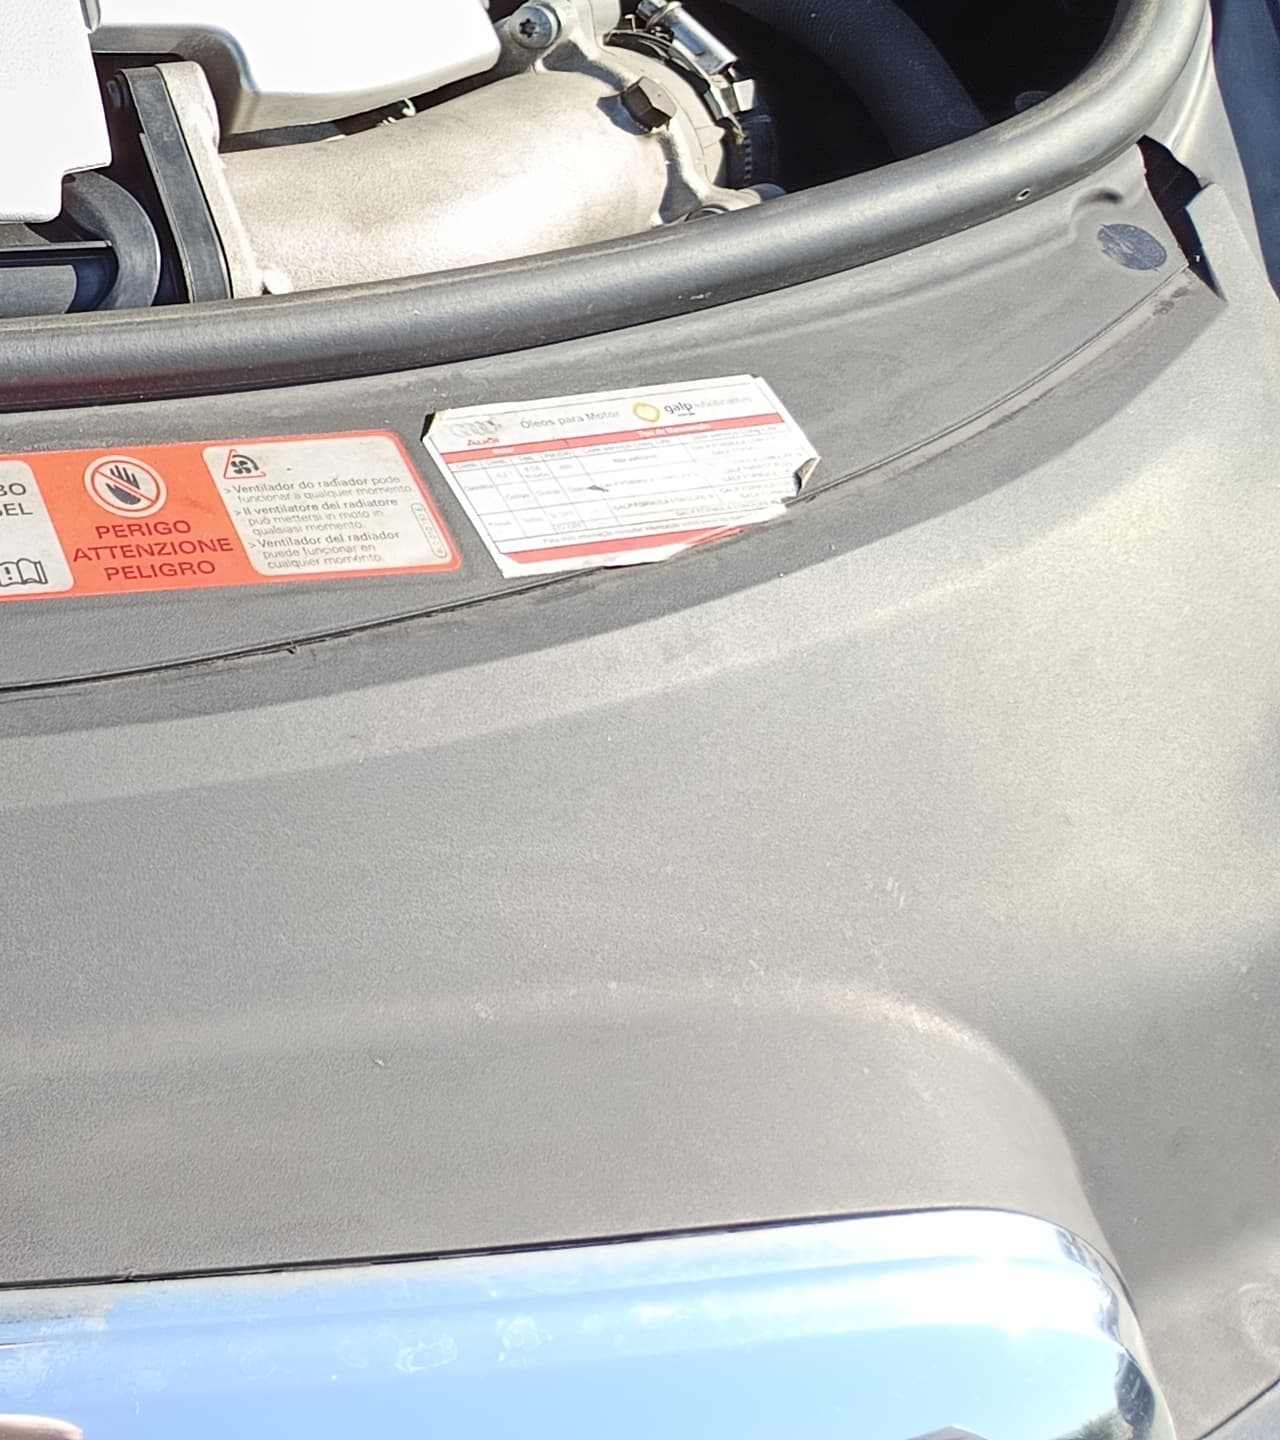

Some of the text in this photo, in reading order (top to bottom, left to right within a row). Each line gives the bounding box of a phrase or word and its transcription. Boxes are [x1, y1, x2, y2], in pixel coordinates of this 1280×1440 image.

[664, 402, 694, 414] galp
[559, 415, 585, 427] para
[233, 475, 401, 493] Ventilador do radiador pode
[238, 491, 291, 503] funcionar
[255, 503, 321, 515] ventilatore
[323, 501, 340, 510] del
[344, 498, 398, 509] radiatore
[339, 509, 369, 519] moto
[95, 520, 191, 539] PERIGO
[257, 531, 400, 549] Ventilador del radiador
[73, 538, 234, 562] ATTENZIONE
[263, 547, 300, 560] puede
[302, 545, 357, 557] funcionar
[104, 560, 216, 581] PELIGRO
[267, 557, 320, 570] cualquier
